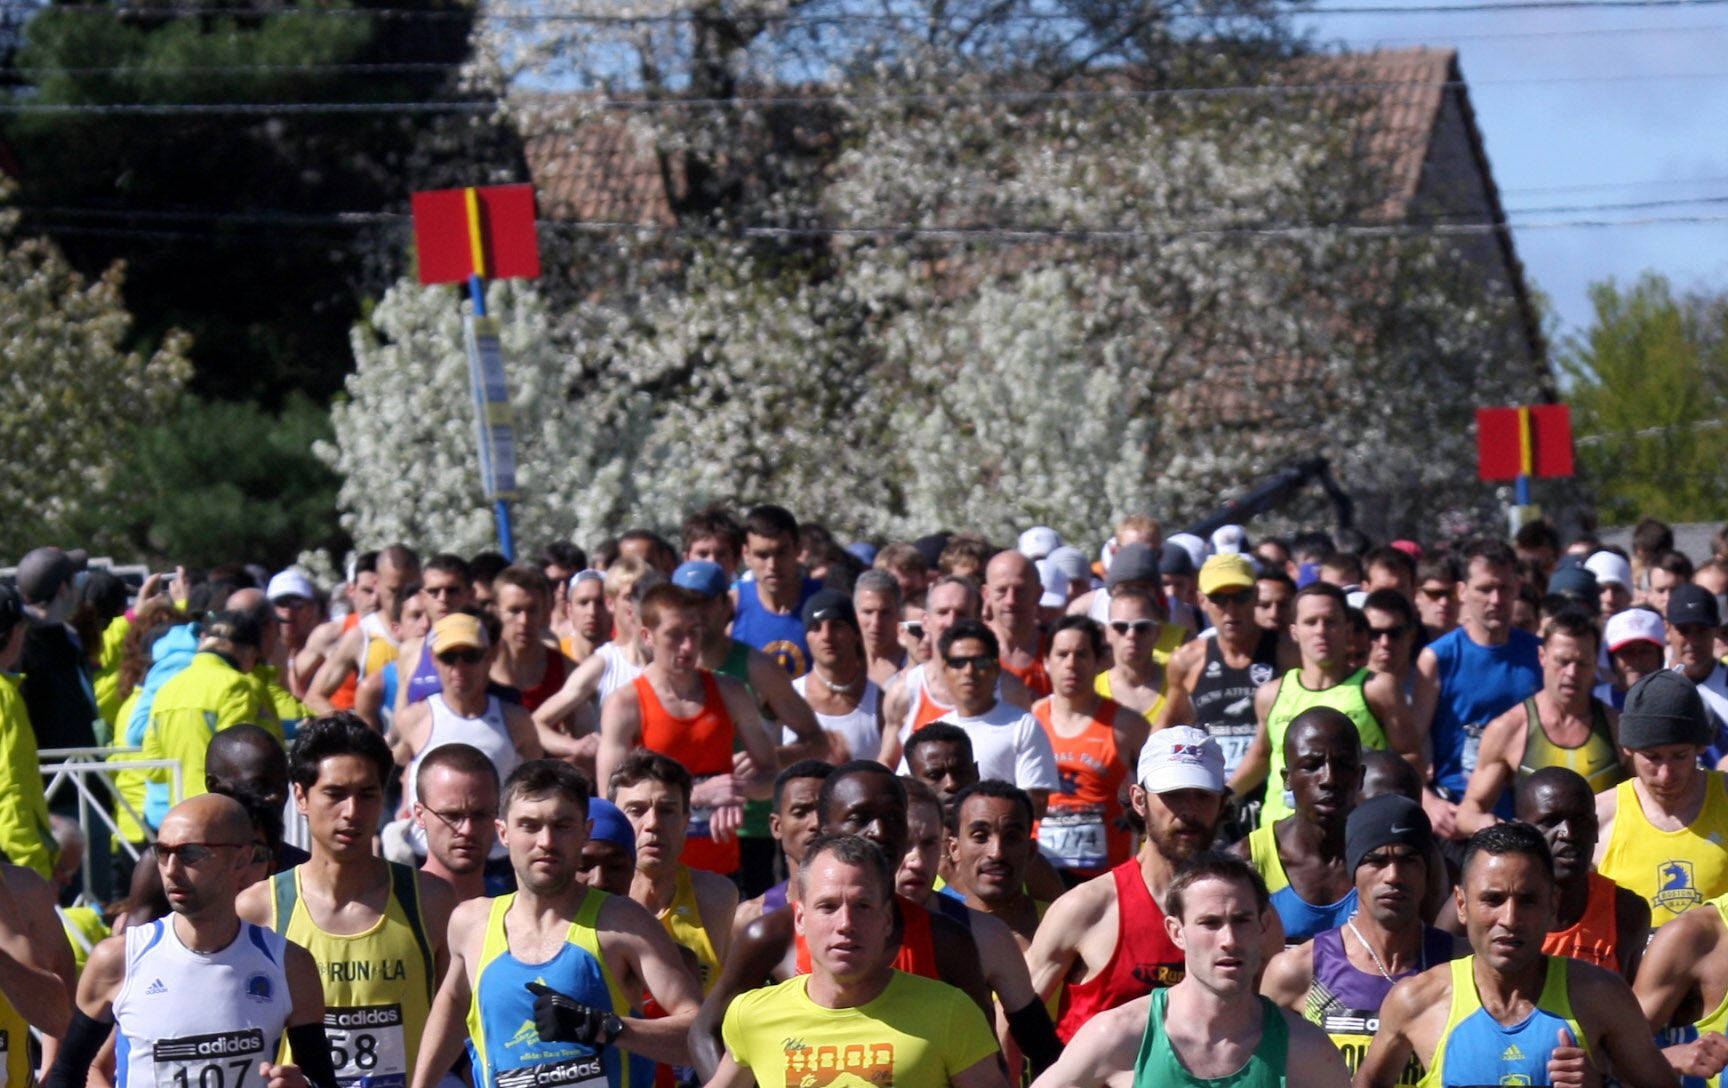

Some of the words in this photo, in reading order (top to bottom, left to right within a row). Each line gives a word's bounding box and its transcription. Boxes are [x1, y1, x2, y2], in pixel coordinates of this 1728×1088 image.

[331, 960, 369, 982] RUN
[382, 959, 406, 980] LA
[338, 1010, 398, 1026] adidas
[198, 1036, 260, 1054] adidas
[537, 1061, 600, 1085] adidas
